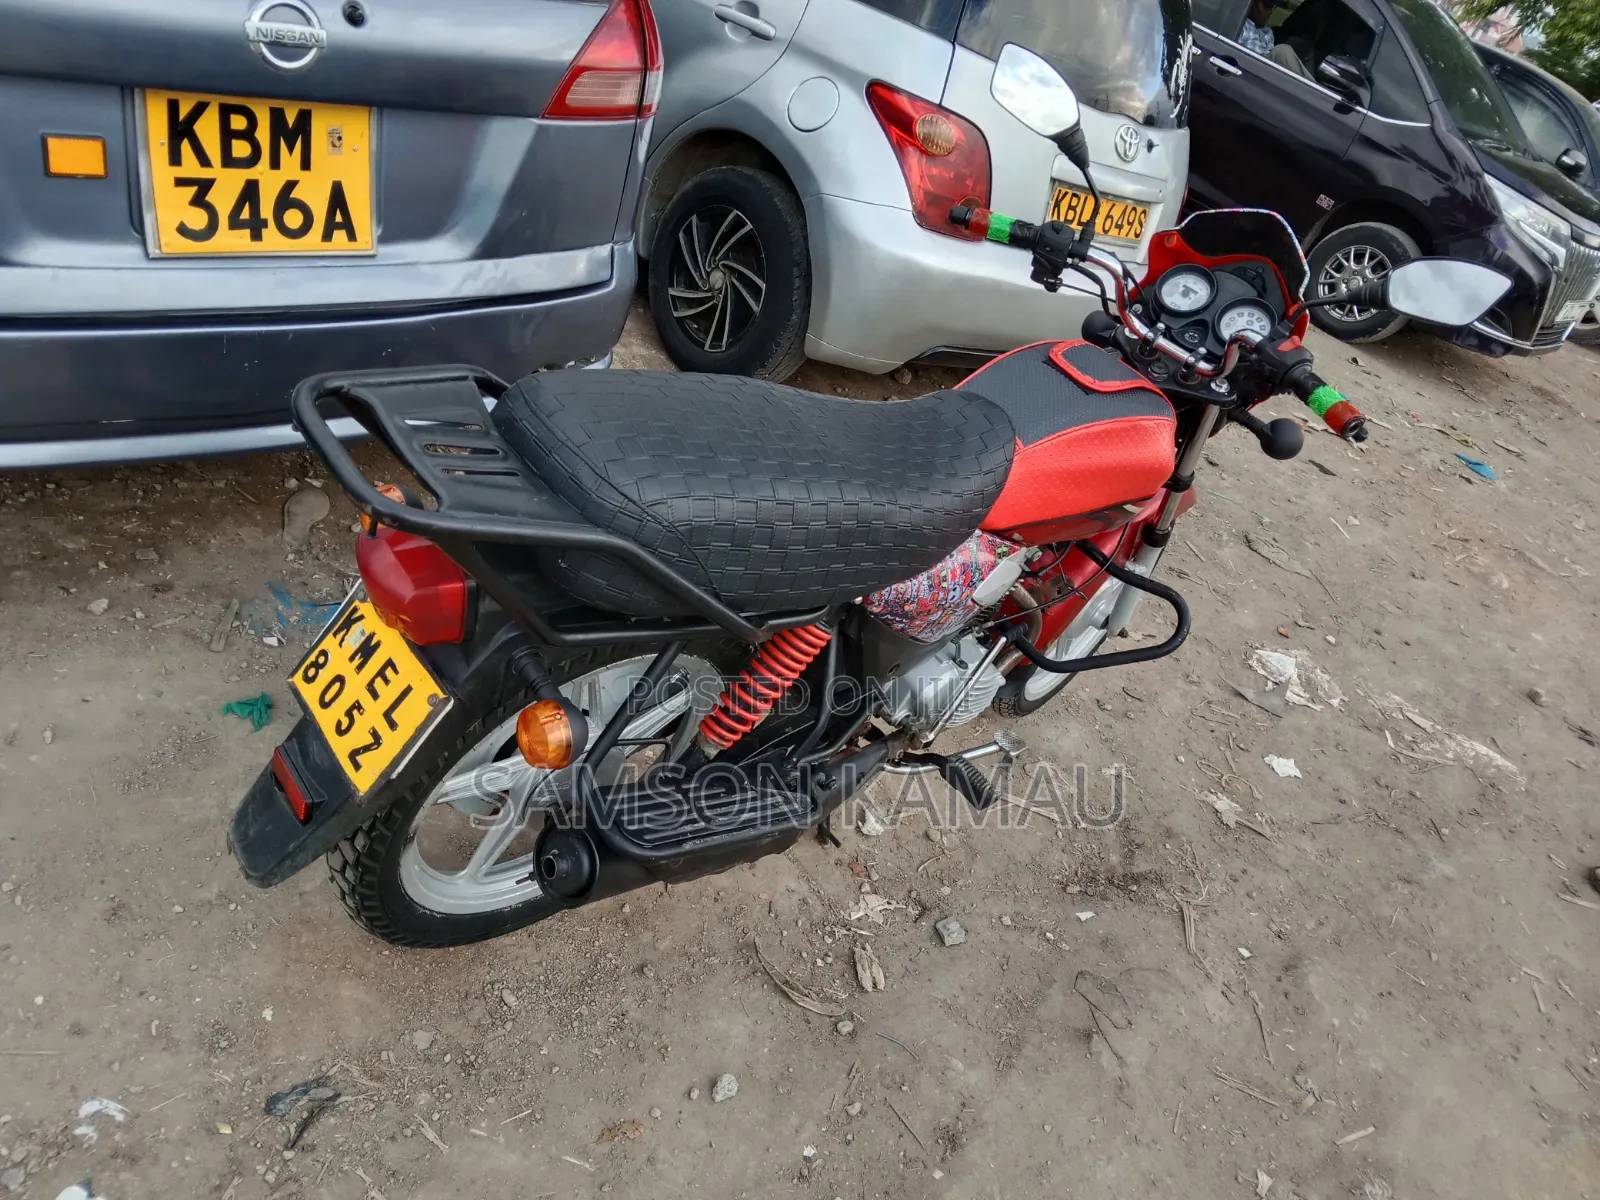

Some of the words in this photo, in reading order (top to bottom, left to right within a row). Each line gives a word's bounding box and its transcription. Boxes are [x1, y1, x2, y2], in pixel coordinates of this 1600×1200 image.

[256, 27, 320, 43] NISSAN
[167, 98, 312, 171] KBM
[174, 177, 357, 243] 346A
[1102, 202, 1147, 239] 649S
[332, 605, 413, 732] KMEL
[302, 649, 383, 773] 805Z
